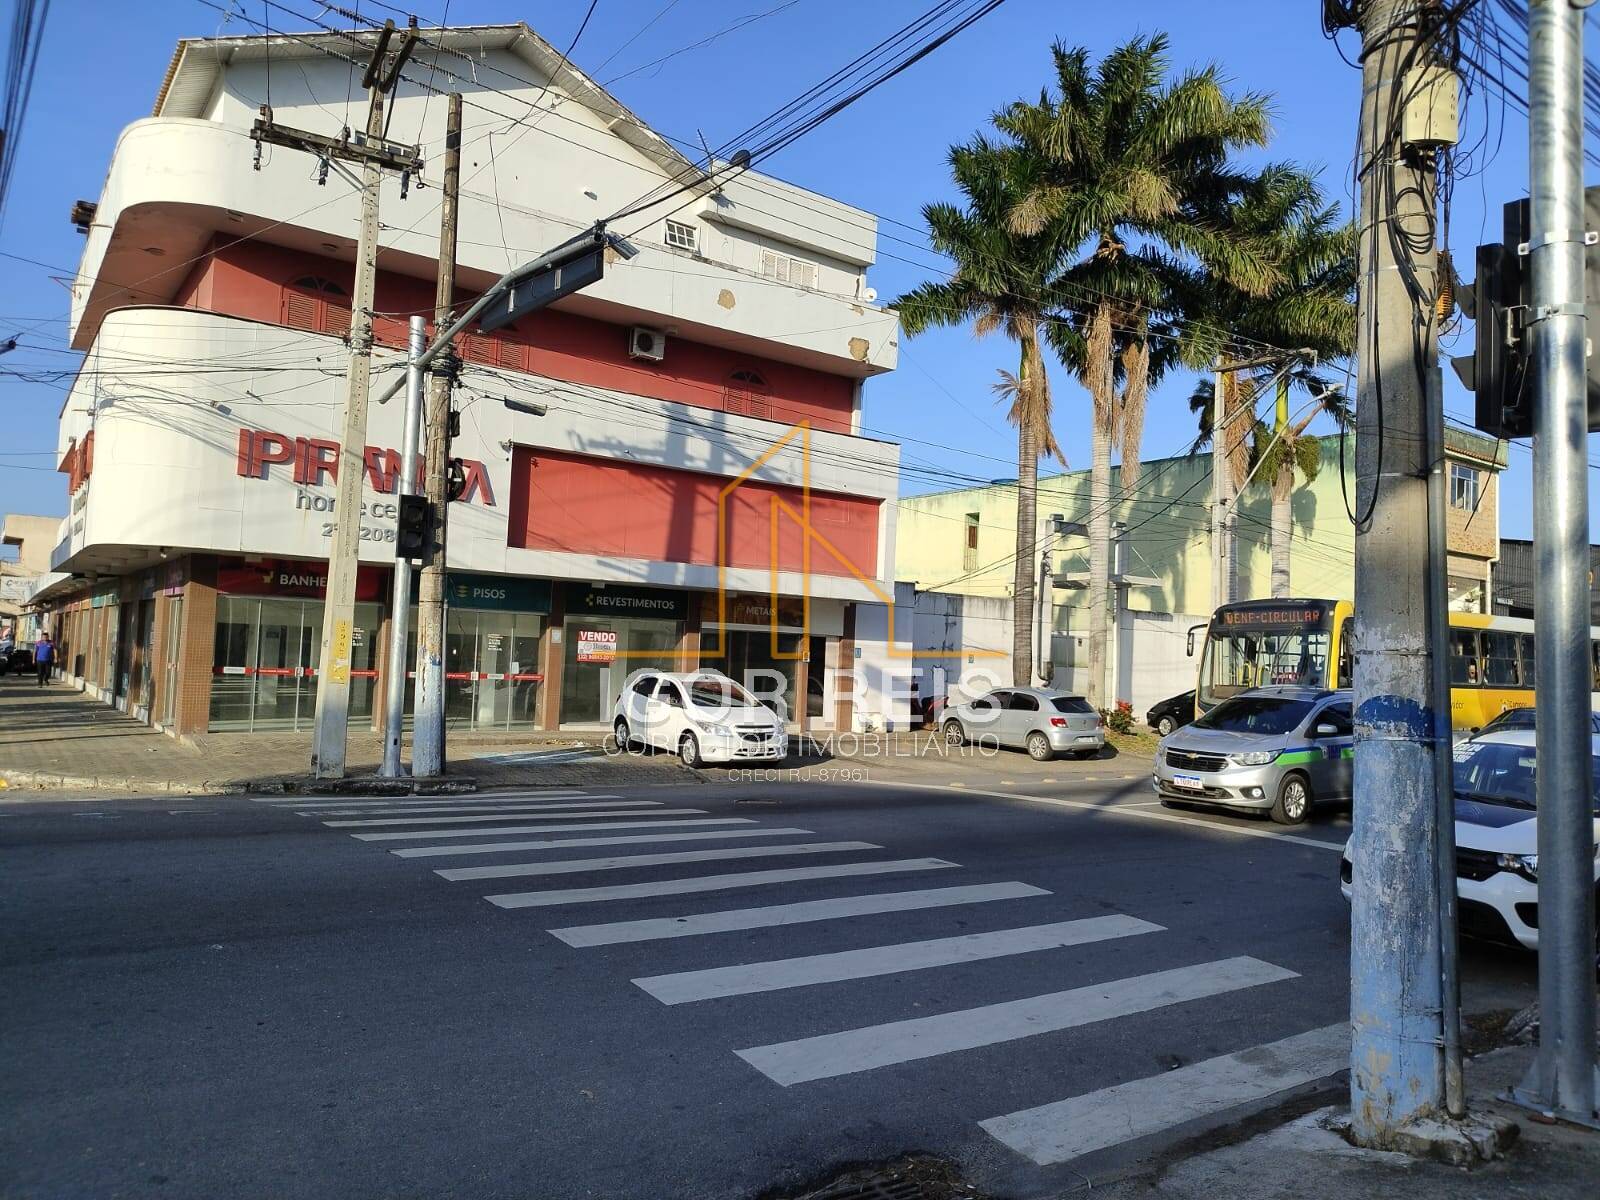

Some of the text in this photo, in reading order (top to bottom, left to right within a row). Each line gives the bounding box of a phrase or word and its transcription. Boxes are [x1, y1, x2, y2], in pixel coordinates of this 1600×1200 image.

[279, 574, 328, 588] BANHE
[473, 587, 506, 599] PISOS
[595, 595, 675, 610] REVESTIMENTOS
[580, 631, 616, 642] VENDO
